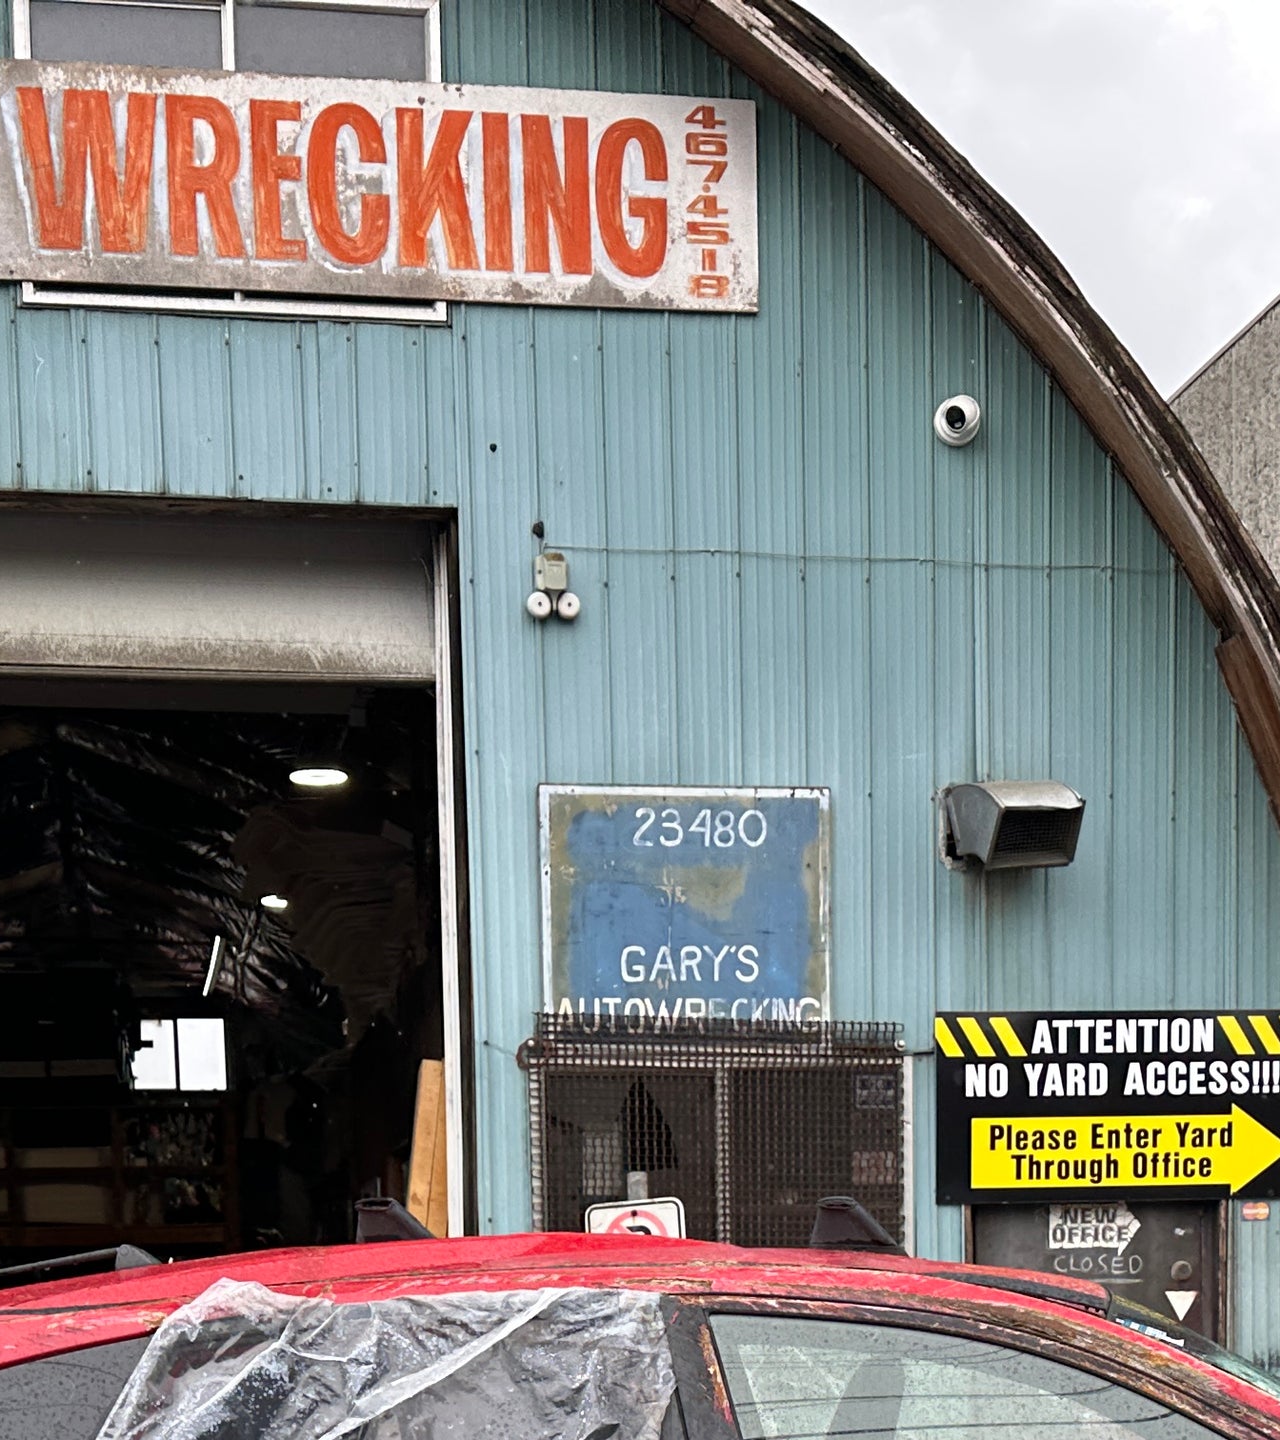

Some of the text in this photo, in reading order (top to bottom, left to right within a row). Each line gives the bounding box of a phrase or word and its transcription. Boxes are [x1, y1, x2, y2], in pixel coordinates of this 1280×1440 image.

[16, 87, 669, 279] WRECKING
[633, 807, 768, 848] 23480
[620, 944, 760, 983] GARY'S
[1030, 1017, 1215, 1055] ATTENTION
[964, 1060, 1280, 1098] NO YARD ACCESS!!!
[988, 1120, 1234, 1151] Please Enter Yard
[1011, 1151, 1213, 1184] Through Office
[1051, 1223, 1130, 1244] OFFICE
[1064, 1207, 1117, 1225] NEW
[1053, 1253, 1143, 1275] CLOSED
